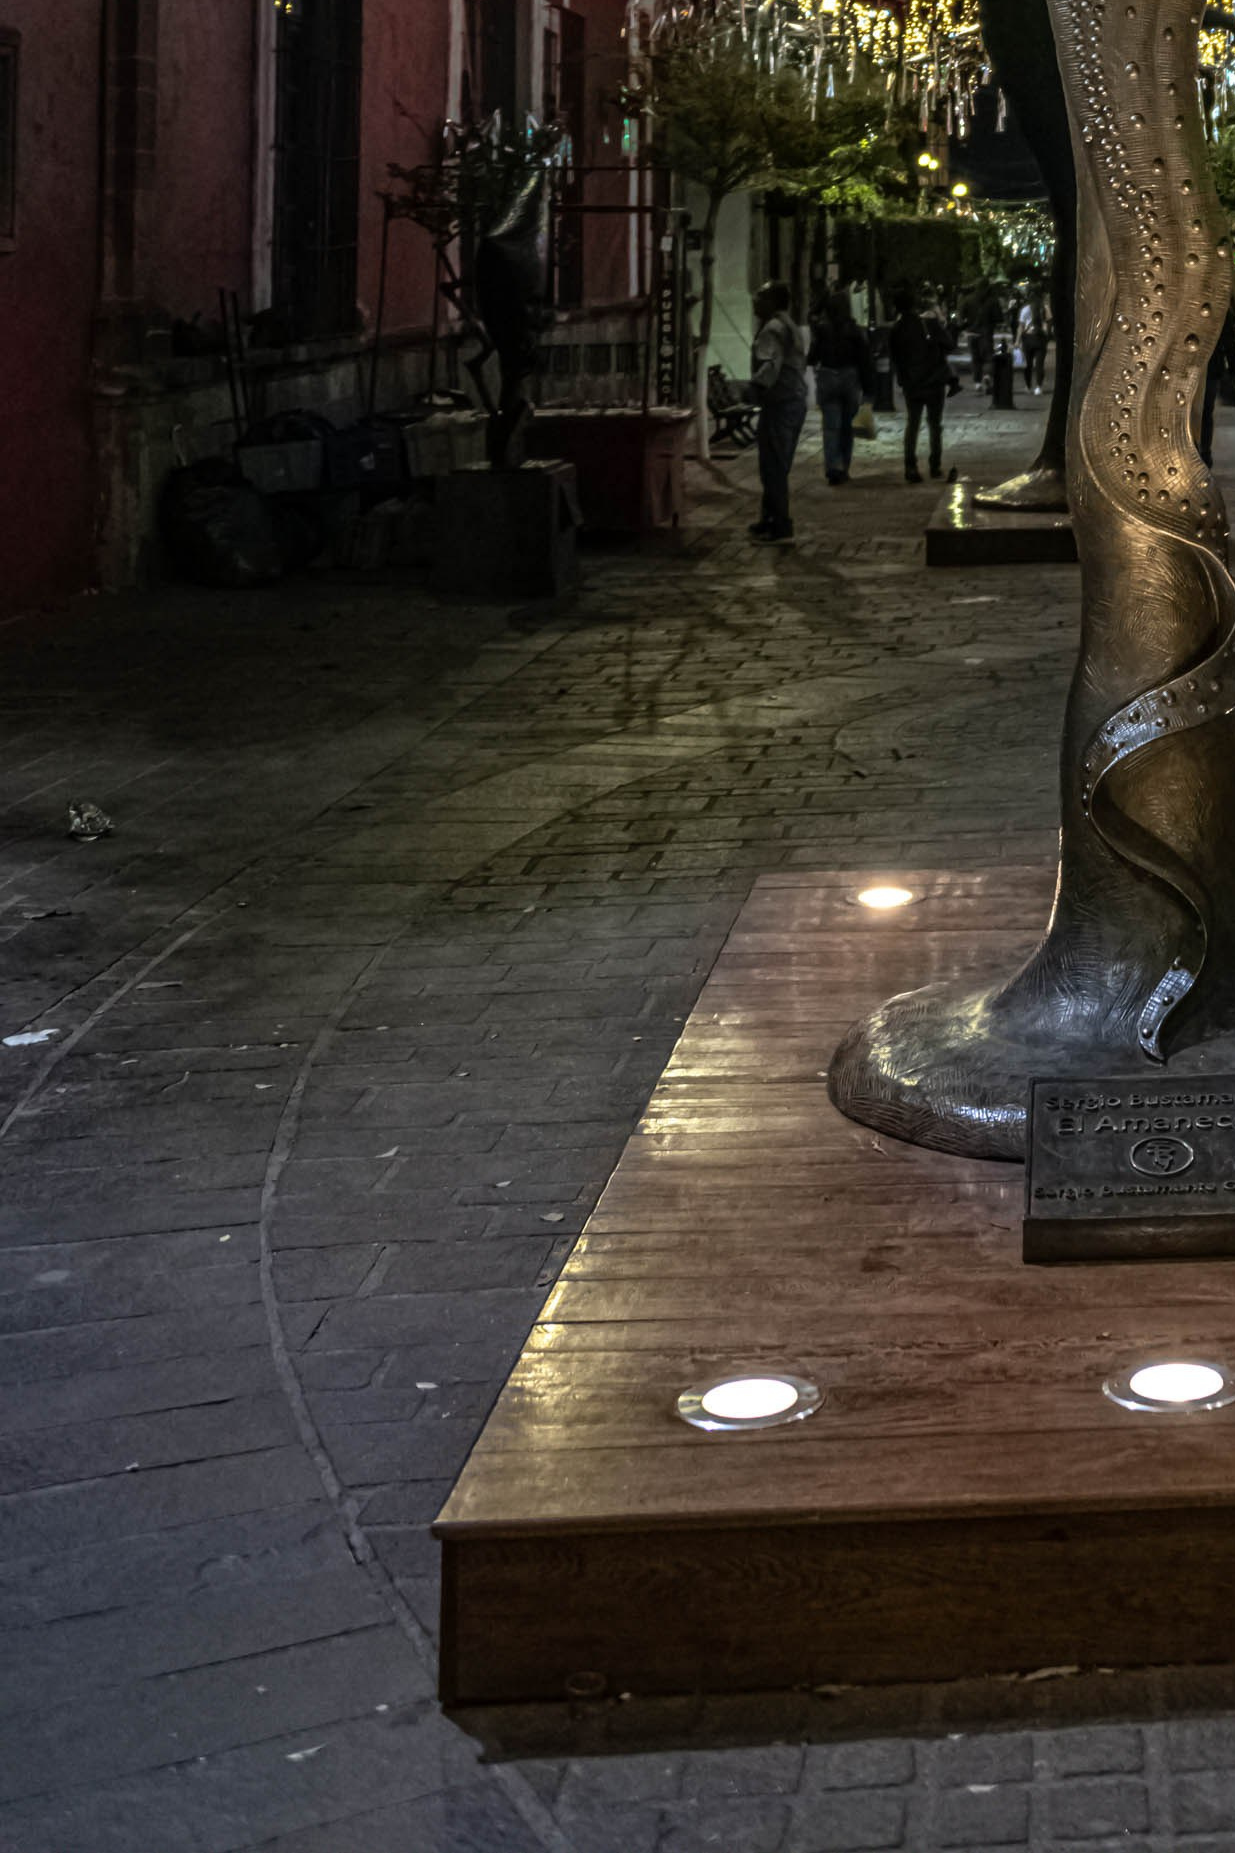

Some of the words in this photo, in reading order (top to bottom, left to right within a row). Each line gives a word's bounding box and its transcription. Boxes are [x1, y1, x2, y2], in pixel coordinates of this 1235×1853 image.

[1044, 1094, 1121, 1112] Sergio
[1057, 1117, 1085, 1135] El
[1034, 1185, 1095, 1200] Sergio
